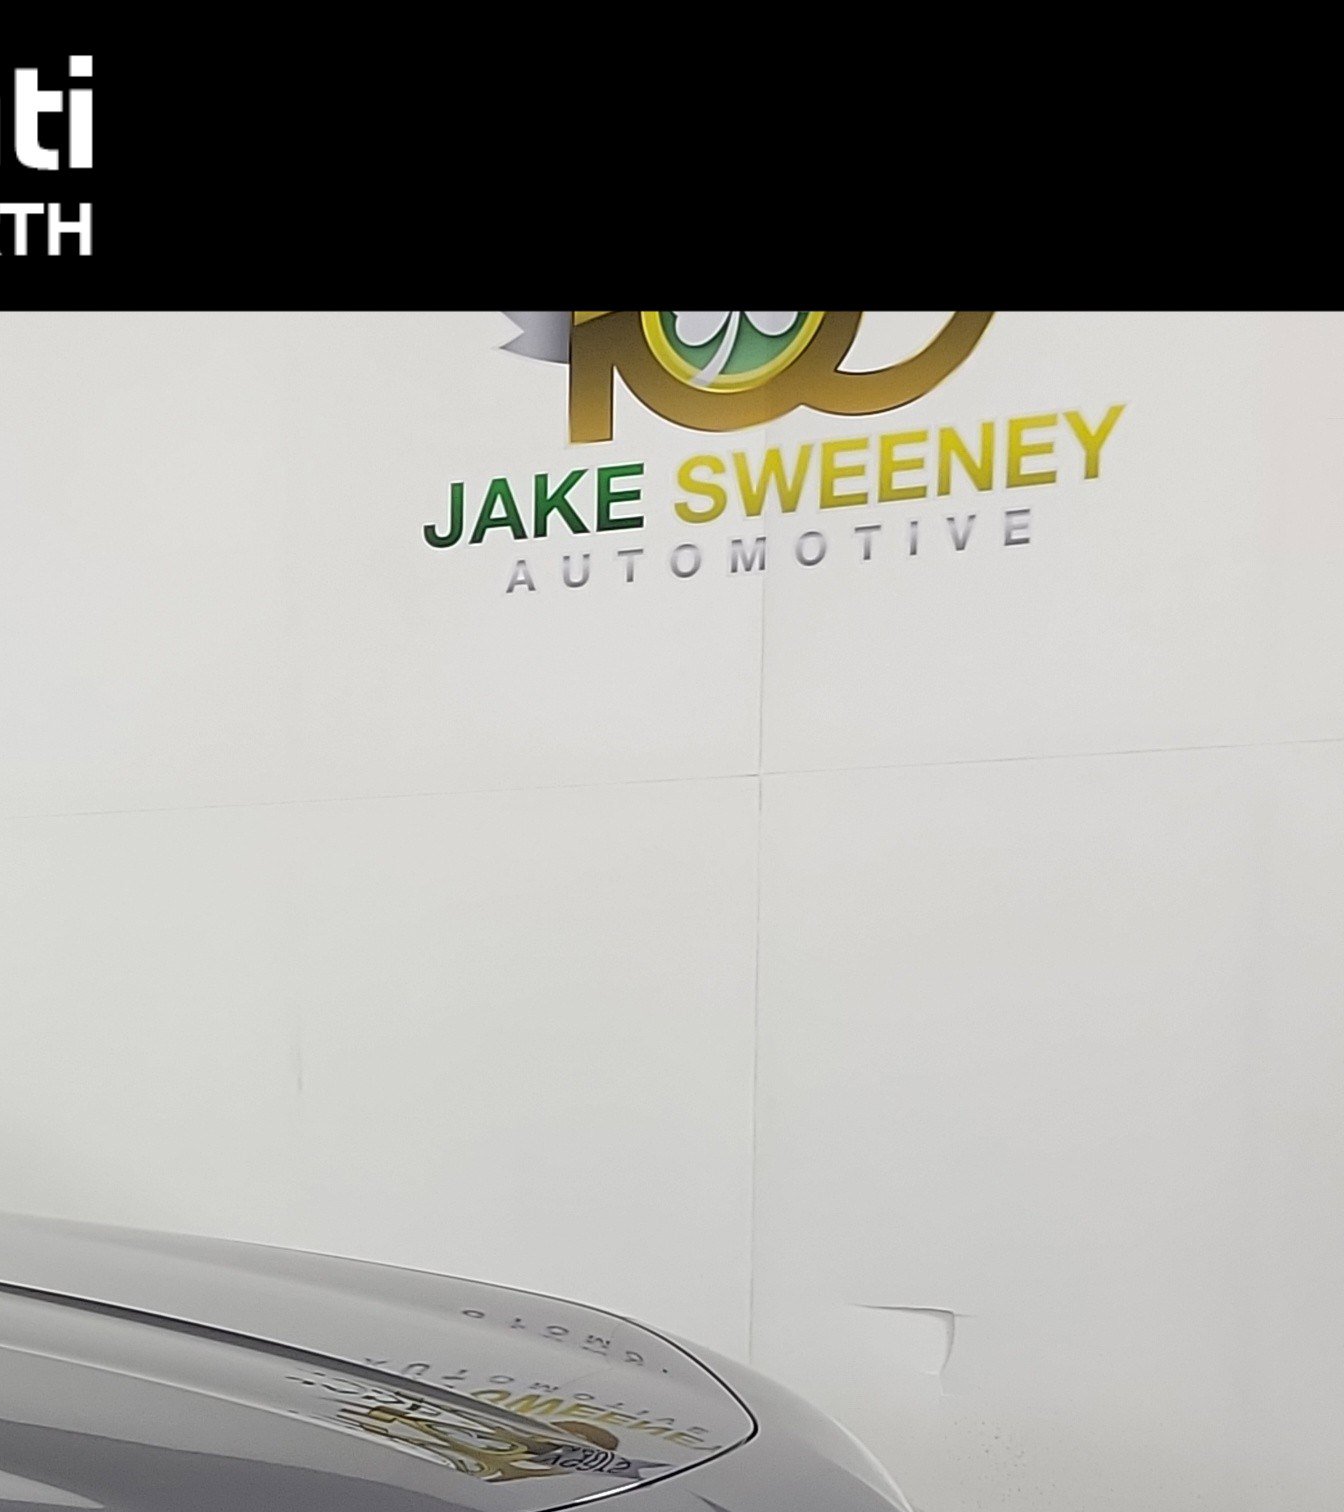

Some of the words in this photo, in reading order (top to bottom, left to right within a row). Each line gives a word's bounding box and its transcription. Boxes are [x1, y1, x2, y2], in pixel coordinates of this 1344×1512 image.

[422, 462, 646, 549] JAKE
[673, 403, 1127, 527] SWEENEY
[505, 508, 1033, 594] AUTOMOTIVE
